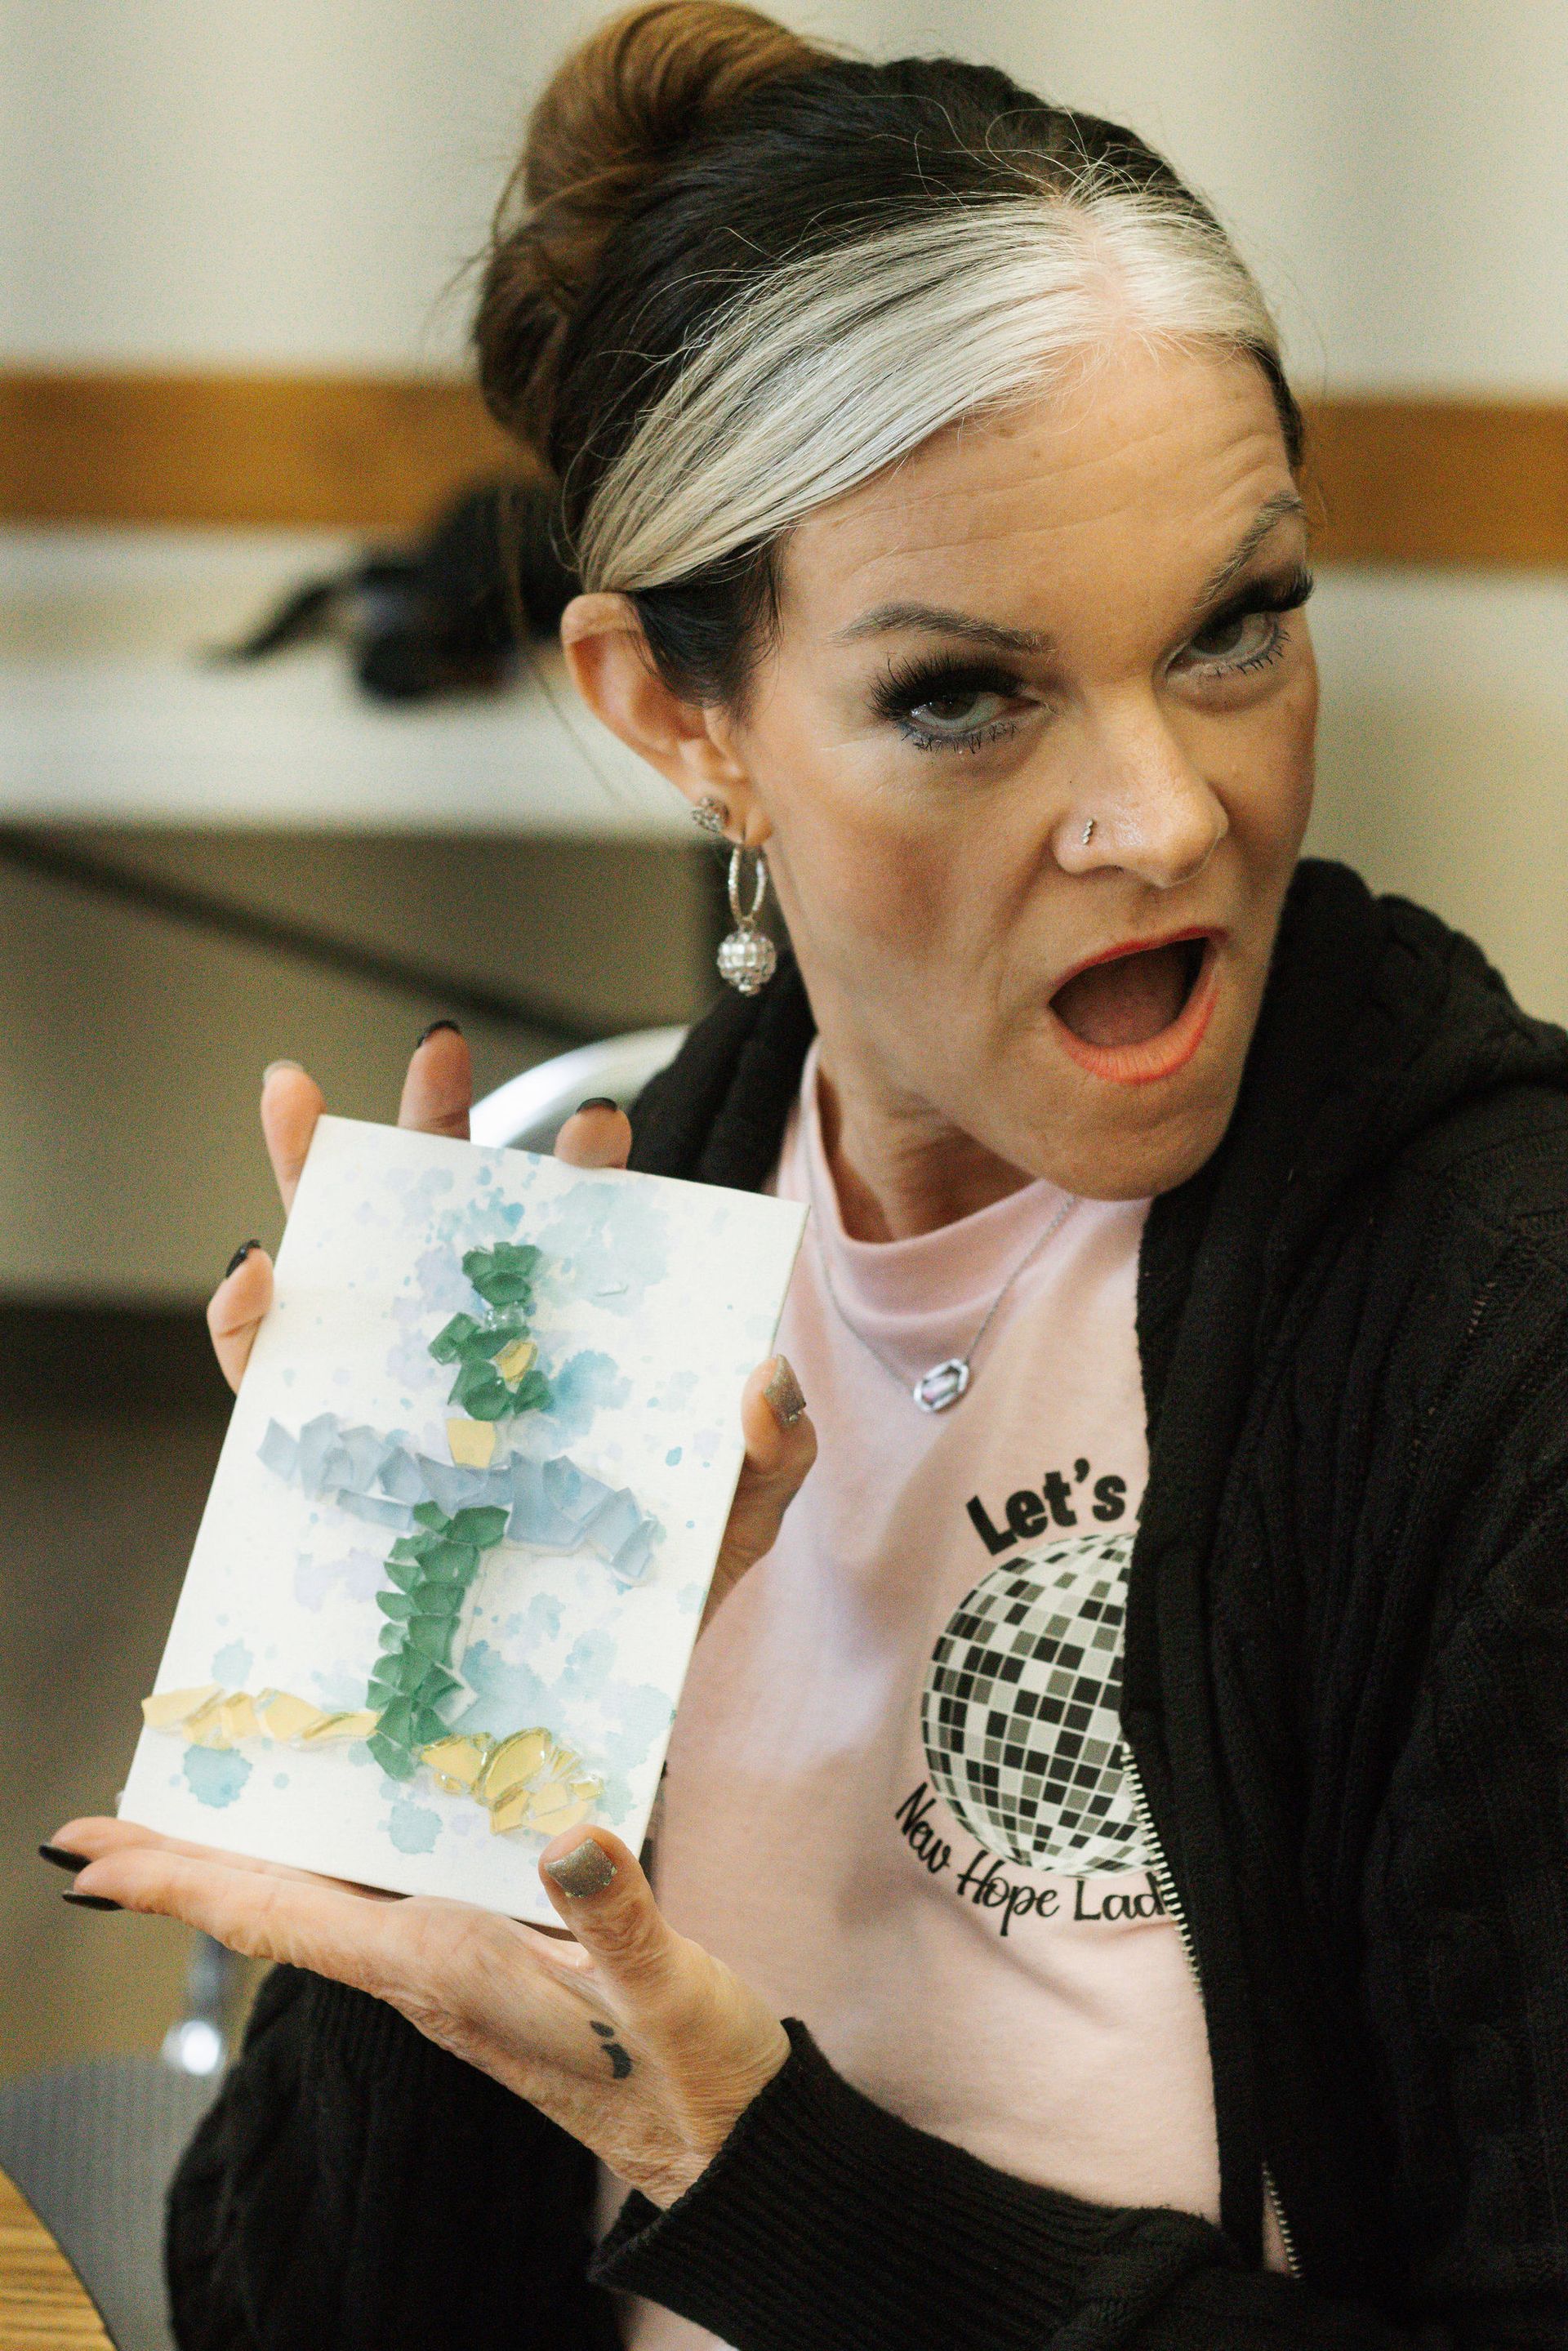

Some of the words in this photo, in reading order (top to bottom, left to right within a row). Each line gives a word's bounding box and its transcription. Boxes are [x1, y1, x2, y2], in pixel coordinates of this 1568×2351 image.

[966, 1458, 1126, 1556] Let's
[895, 1782, 951, 1873] New
[956, 1849, 1059, 1936] Hope
